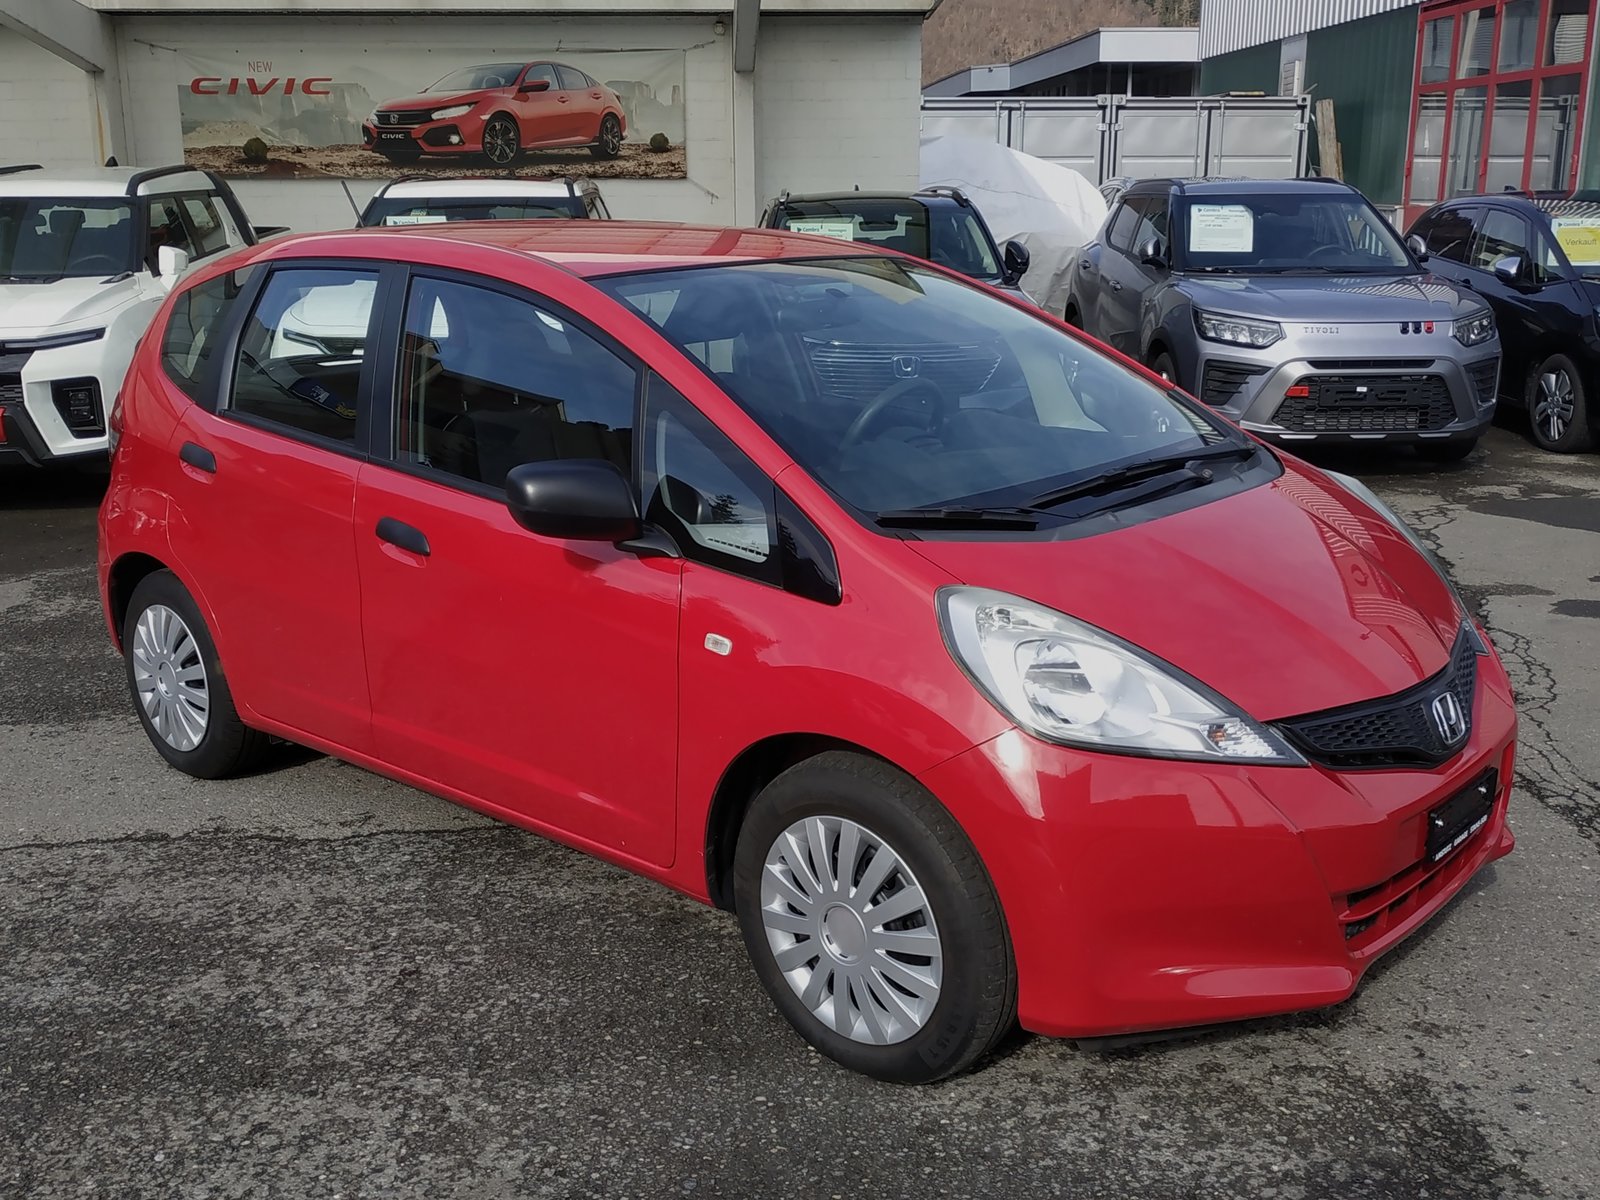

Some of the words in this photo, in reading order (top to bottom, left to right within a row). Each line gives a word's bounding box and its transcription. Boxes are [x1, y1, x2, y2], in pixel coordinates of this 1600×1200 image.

[248, 61, 273, 73] NEW
[190, 77, 333, 95] CIVIC
[1303, 326, 1339, 334] TIVOLI
